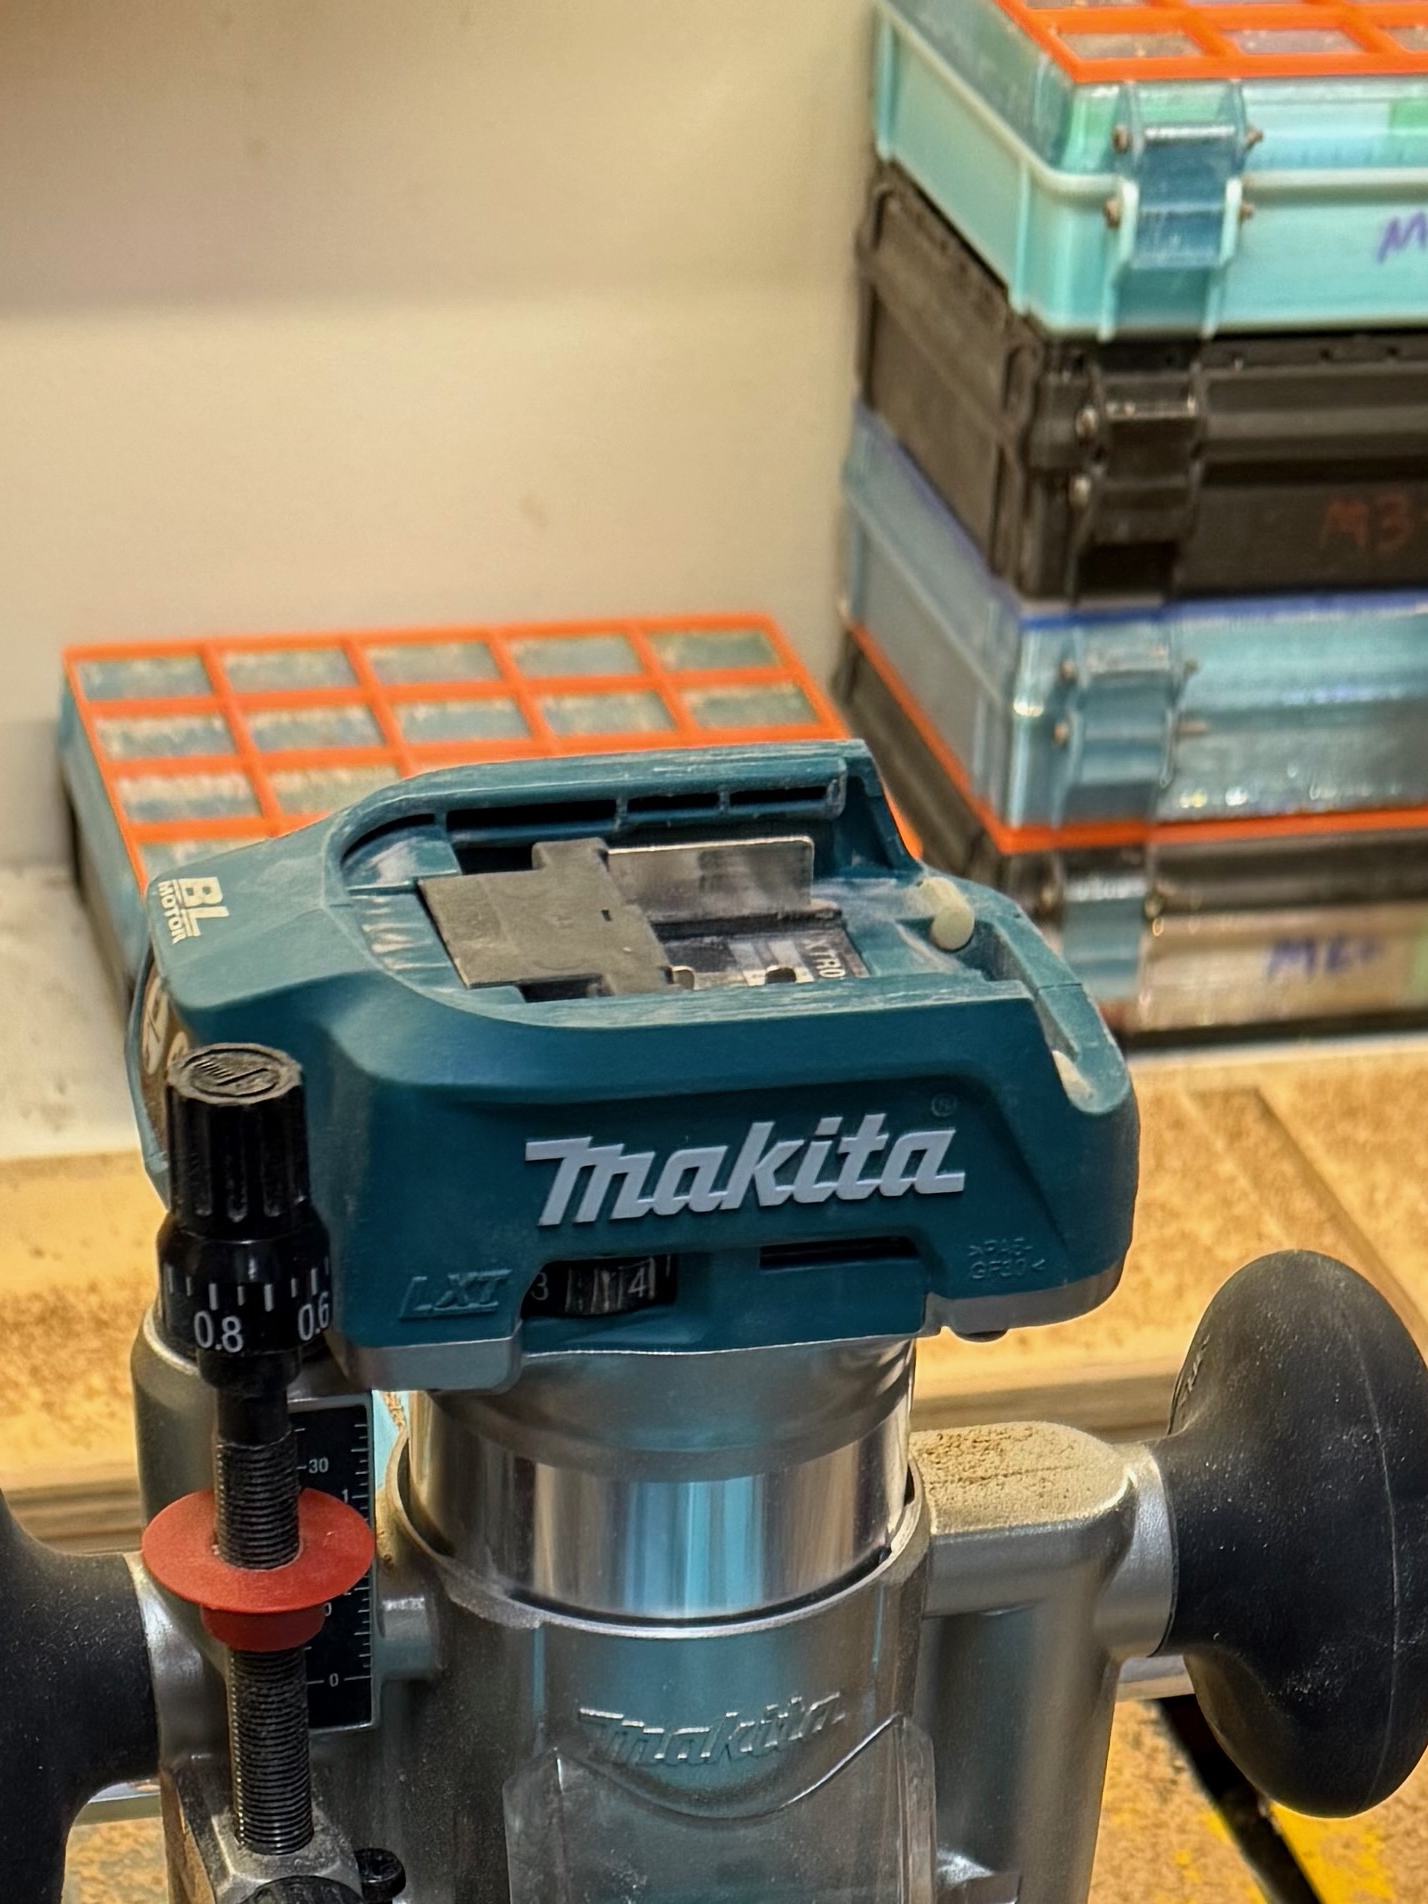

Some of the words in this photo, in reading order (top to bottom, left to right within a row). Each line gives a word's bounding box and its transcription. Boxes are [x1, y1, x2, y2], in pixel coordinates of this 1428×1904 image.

[158, 880, 187, 944] MOTOR
[178, 876, 230, 937] BL
[399, 1268, 512, 1321] LXT
[531, 1272, 549, 1301] 3
[627, 1268, 647, 1298] 4
[192, 1309, 245, 1353] 0.8
[297, 1291, 332, 1342] 0.6
[308, 1457, 330, 1474] 30
[329, 1673, 340, 1687] 0
